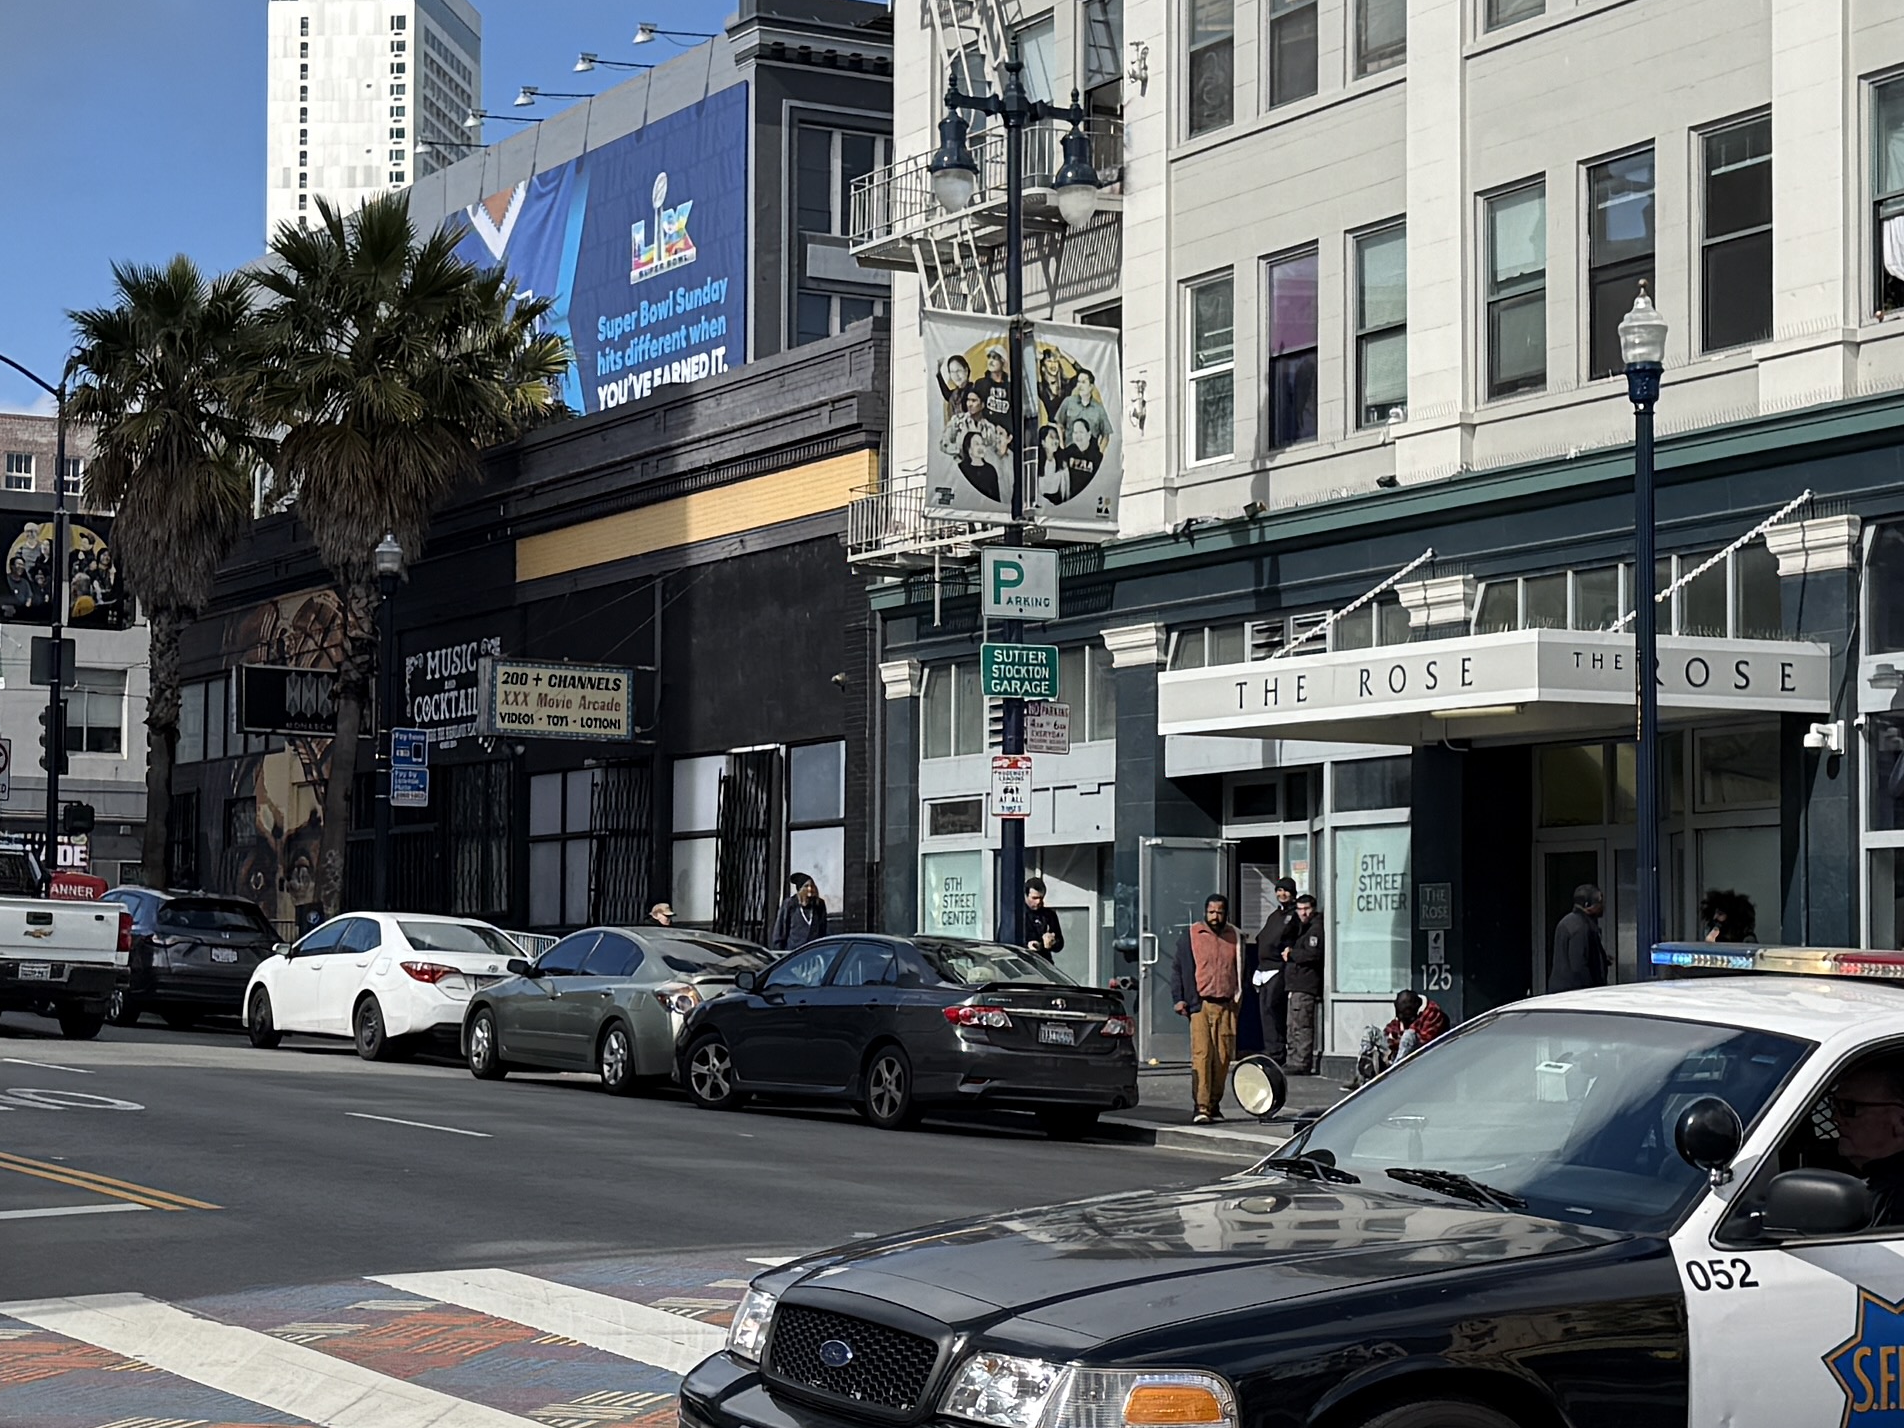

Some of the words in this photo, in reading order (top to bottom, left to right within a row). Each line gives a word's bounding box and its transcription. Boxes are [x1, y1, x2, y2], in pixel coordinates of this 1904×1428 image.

[597, 309, 638, 342] Super
[640, 291, 674, 329] Bowl
[675, 276, 728, 314] Sunday
[597, 349, 623, 377] hits
[624, 324, 687, 368] different
[689, 314, 727, 345] when
[597, 371, 652, 411] YOU'VE
[653, 351, 710, 388] EARNED
[710, 345, 729, 373] IT.
[426, 641, 478, 681] MUSIC
[993, 649, 1047, 664] SUTTER
[1573, 652, 1623, 669] THE
[992, 664, 1050, 679] STOCKTON
[501, 671, 528, 687] 200
[532, 673, 543, 686] +
[548, 674, 622, 692] CHANNELS
[991, 679, 1050, 694] GARAGE
[1235, 675, 1307, 709] THE
[1359, 657, 1473, 697] ROSE
[501, 690, 531, 707] XXX
[536, 692, 573, 710] Movie
[578, 695, 621, 712] Arcade
[1041, 704, 1069, 718] PARKING
[499, 712, 534, 725] VIDEOS
[547, 714, 569, 727] TOYS
[580, 717, 621, 730] LOTIONS
[56, 844, 88, 867] DE
[1361, 853, 1386, 872] 6TH
[49, 883, 95, 899] ANNER
[944, 877, 962, 891] 6TH
[1359, 872, 1407, 892] STREET
[943, 893, 977, 908] STREET
[1357, 893, 1408, 912] CENTER
[1425, 887, 1446, 902] THE
[942, 910, 977, 926] CENTER
[1421, 905, 1449, 919] ROSE
[1421, 964, 1452, 991] 125
[1686, 1257, 1759, 1293] 052
